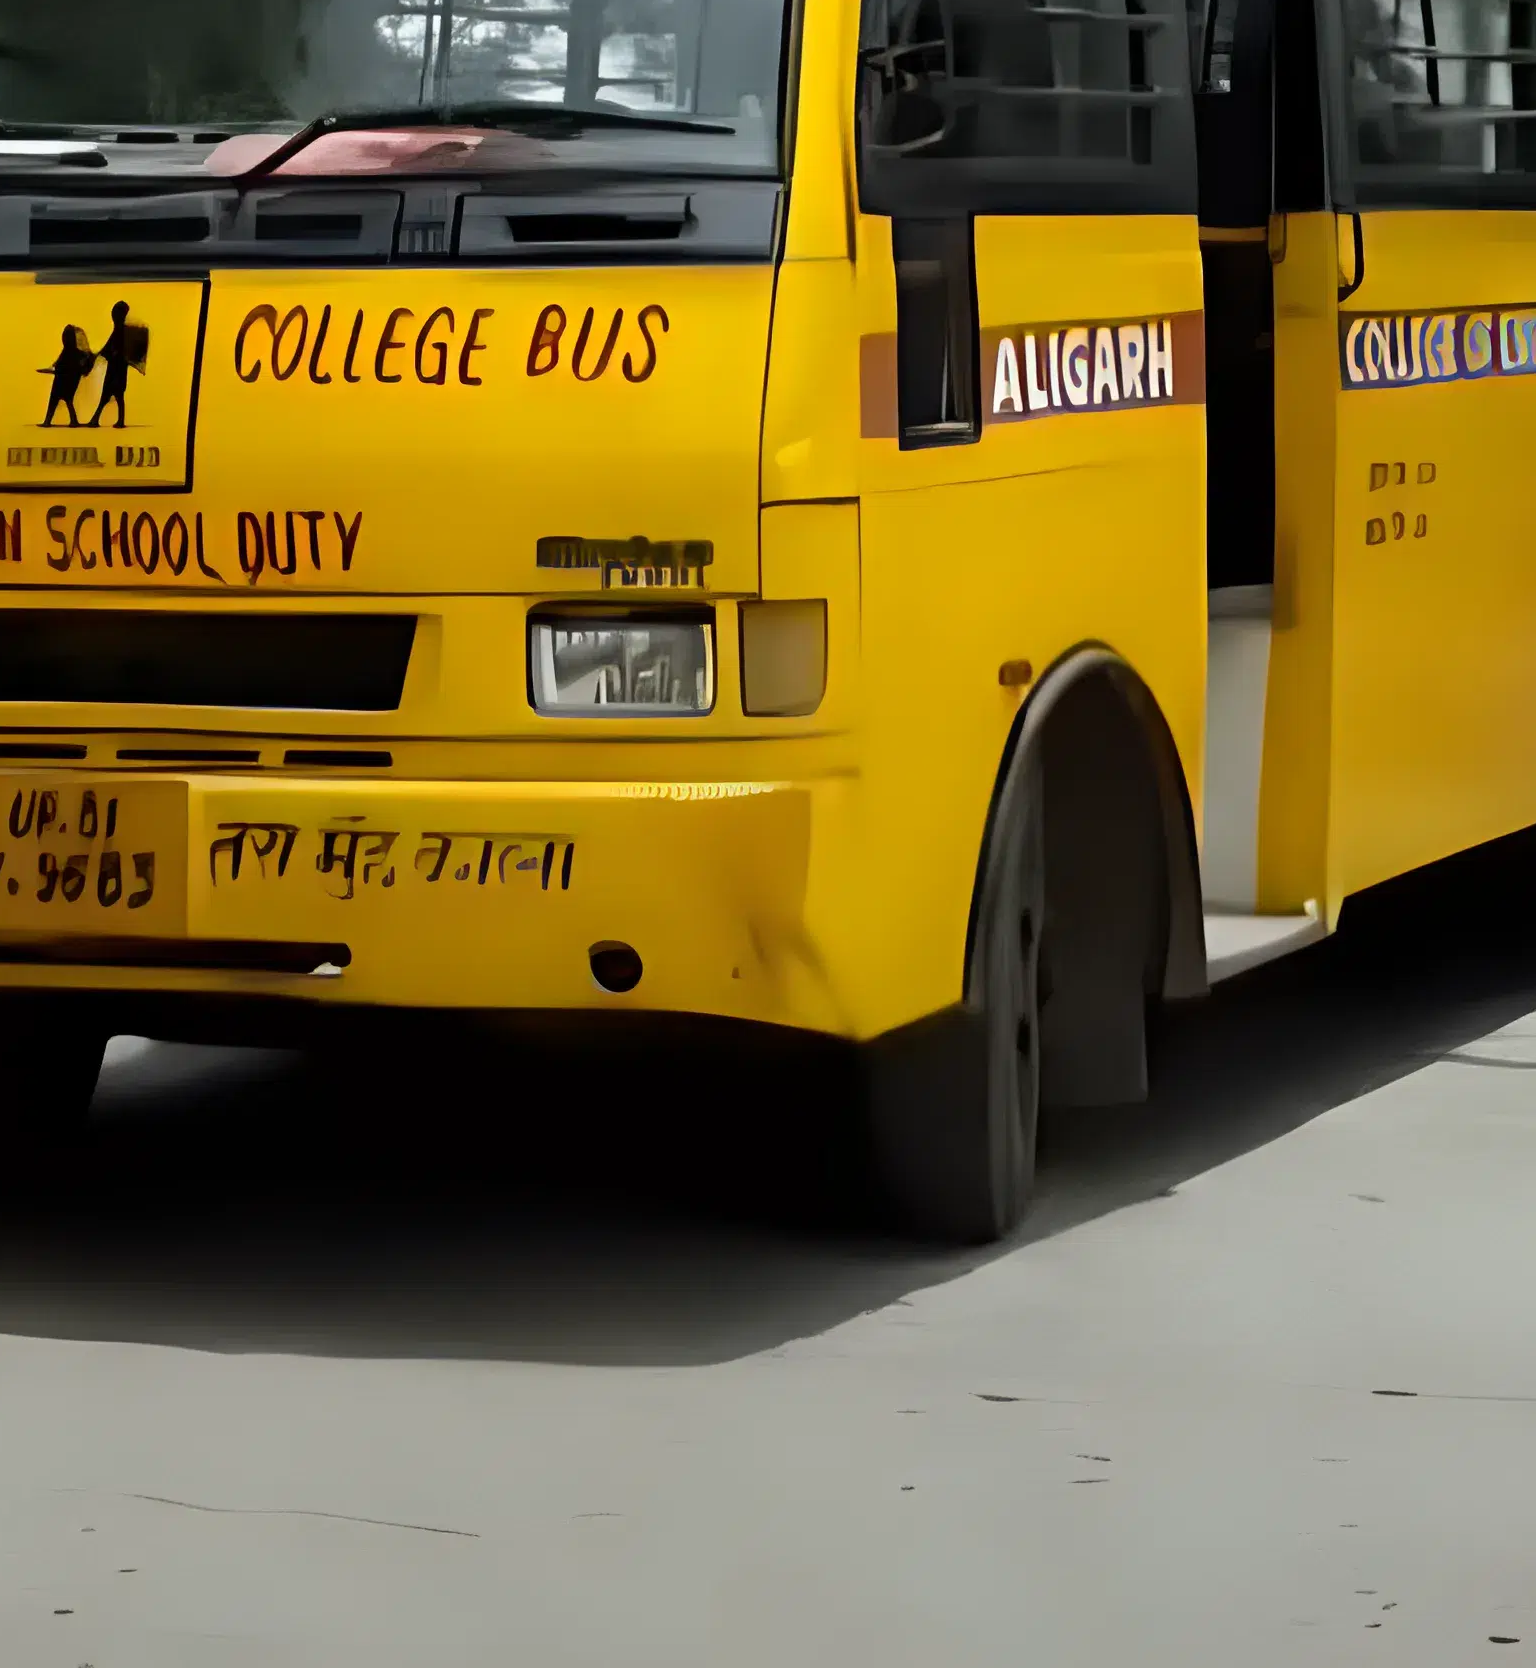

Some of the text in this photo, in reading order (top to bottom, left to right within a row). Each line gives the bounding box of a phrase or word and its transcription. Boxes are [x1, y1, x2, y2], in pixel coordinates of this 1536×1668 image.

[234, 303, 670, 387] COLLEGE BUS
[992, 319, 1174, 414] ALIGARH
[45, 504, 229, 586] SCHOOL
[237, 510, 363, 586] DUTY
